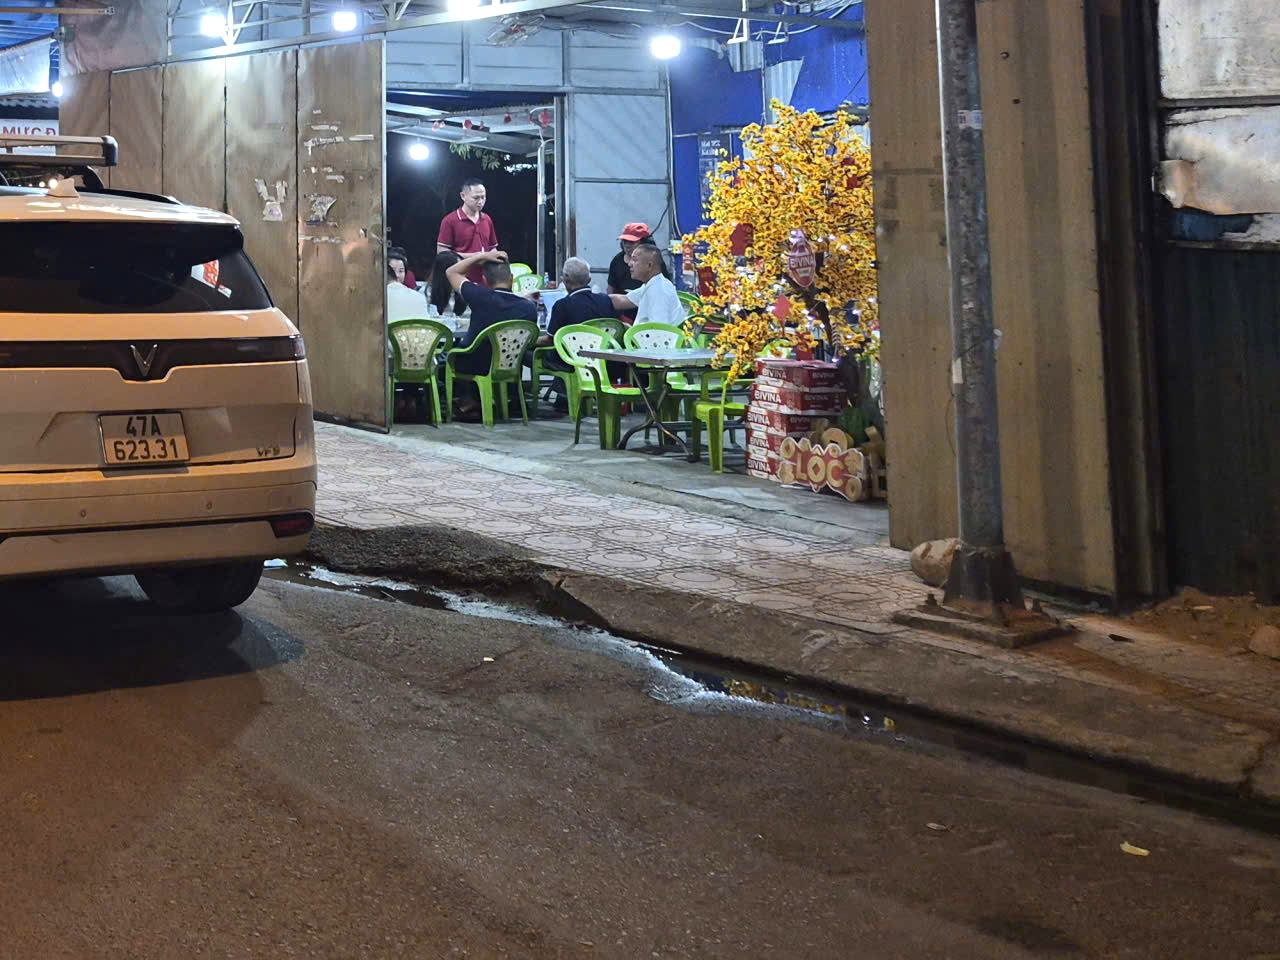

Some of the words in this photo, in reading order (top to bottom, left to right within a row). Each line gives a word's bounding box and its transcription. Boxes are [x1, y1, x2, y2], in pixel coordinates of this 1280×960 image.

[790, 255, 816, 269] BIVINA
[762, 368, 787, 378] BIVINA
[754, 390, 781, 403] BIVINA
[747, 412, 770, 425] BIVINA
[126, 416, 161, 437] 47A
[113, 438, 179, 461] 623.31
[747, 459, 771, 472] BIVINA
